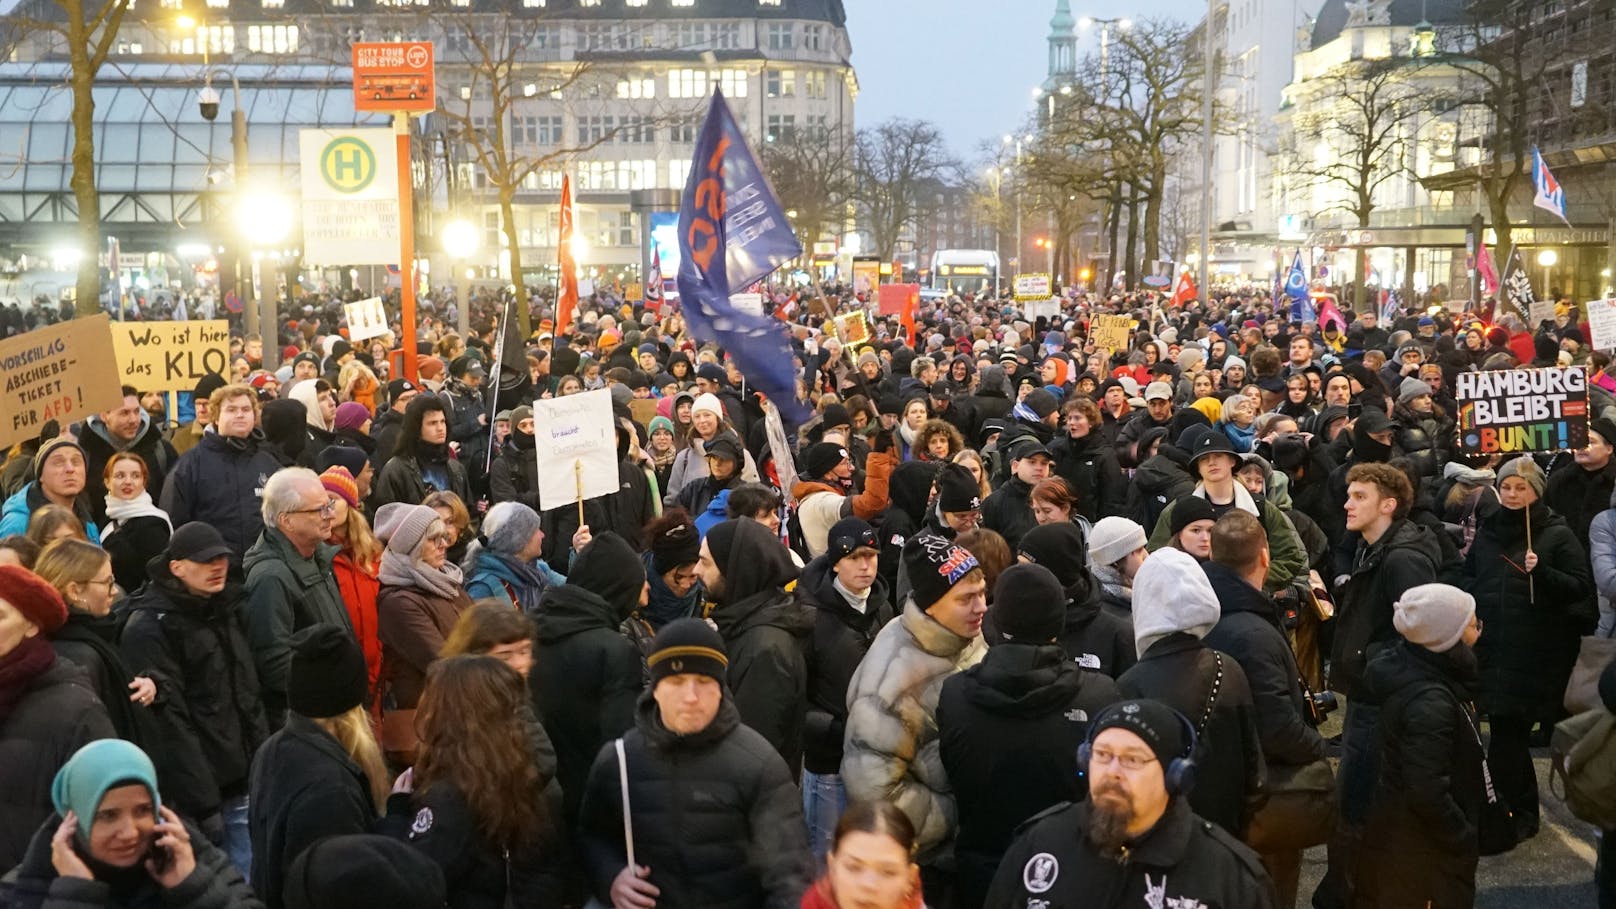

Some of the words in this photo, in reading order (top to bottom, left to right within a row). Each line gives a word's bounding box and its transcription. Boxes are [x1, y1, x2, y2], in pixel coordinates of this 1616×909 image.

[358, 57, 378, 67] BUS
[379, 57, 405, 67] STOP
[335, 149, 362, 181] H
[128, 327, 162, 347] Wo
[172, 326, 191, 345] ist
[199, 325, 228, 343] hier
[0, 338, 65, 372] VORSCHLAG
[126, 357, 152, 376] das
[165, 347, 226, 381] KLO
[6, 358, 77, 394] ABSCHIEBE-
[18, 380, 62, 405] TICKET
[1457, 367, 1586, 400] HAMBURG
[13, 409, 38, 431] FÜR
[43, 396, 72, 421] AFD
[1474, 393, 1568, 426] BLEIBT
